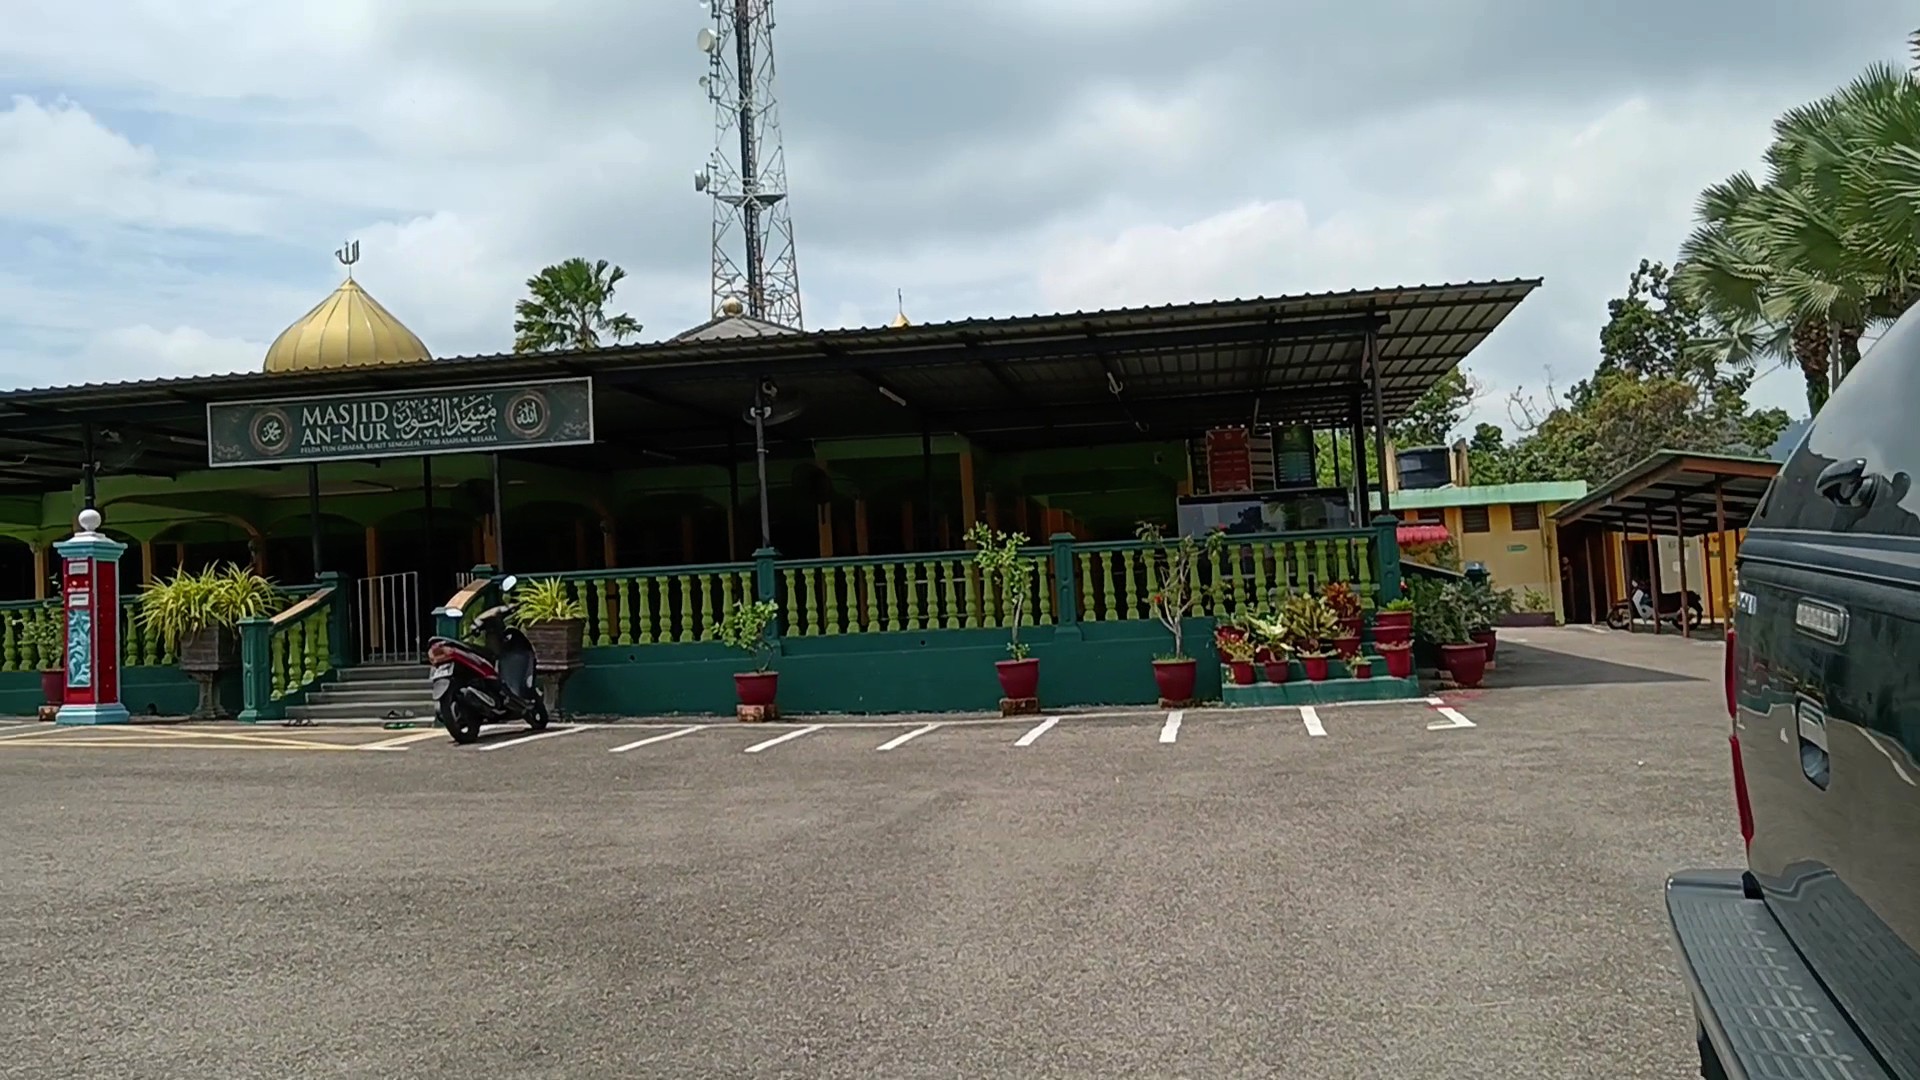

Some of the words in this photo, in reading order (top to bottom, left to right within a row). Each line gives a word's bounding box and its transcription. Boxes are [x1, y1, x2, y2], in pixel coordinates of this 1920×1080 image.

[301, 401, 389, 428] MASJID
[301, 423, 391, 446] AN-NUR
[470, 435, 498, 443] MELAKA
